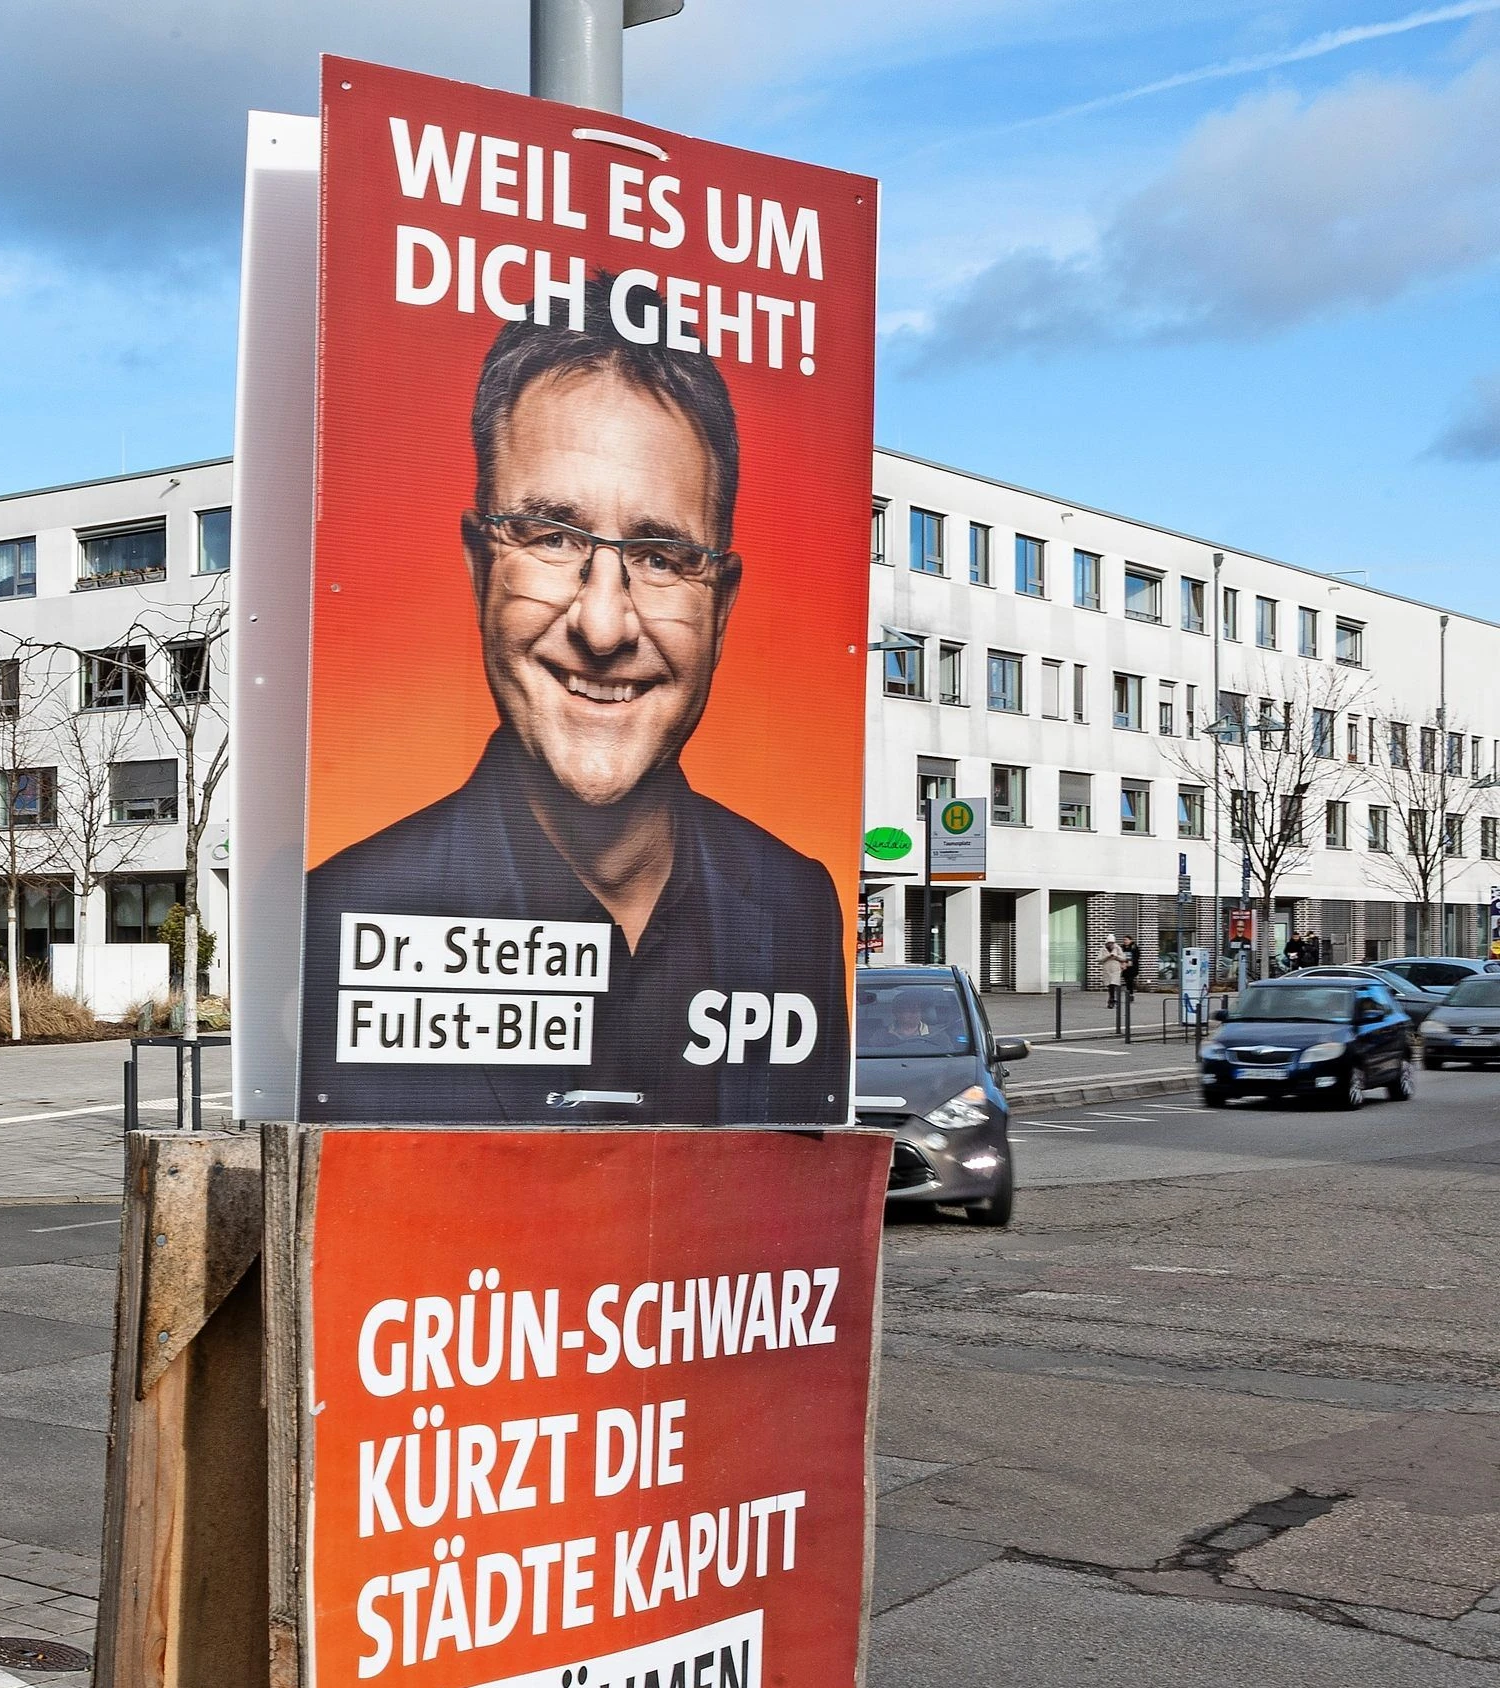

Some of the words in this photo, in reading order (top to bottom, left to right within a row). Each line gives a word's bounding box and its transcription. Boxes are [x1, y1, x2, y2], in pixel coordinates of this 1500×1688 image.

[389, 116, 587, 230] WEIL
[609, 162, 686, 249] ES
[706, 187, 824, 281] UM
[395, 224, 586, 332] DICH
[609, 268, 816, 376] GEHT!
[353, 922, 423, 972] Dr.
[444, 925, 598, 978] Stefan
[350, 997, 582, 1051] Fulst-Blei
[683, 989, 818, 1066] SPD
[358, 1267, 840, 1398] GRÜN-SCHWARZ
[358, 1404, 578, 1538] KÜRZT
[594, 1399, 687, 1498] DIE
[356, 1534, 597, 1680] STÄDTE
[612, 1490, 806, 1619] KAPUTT
